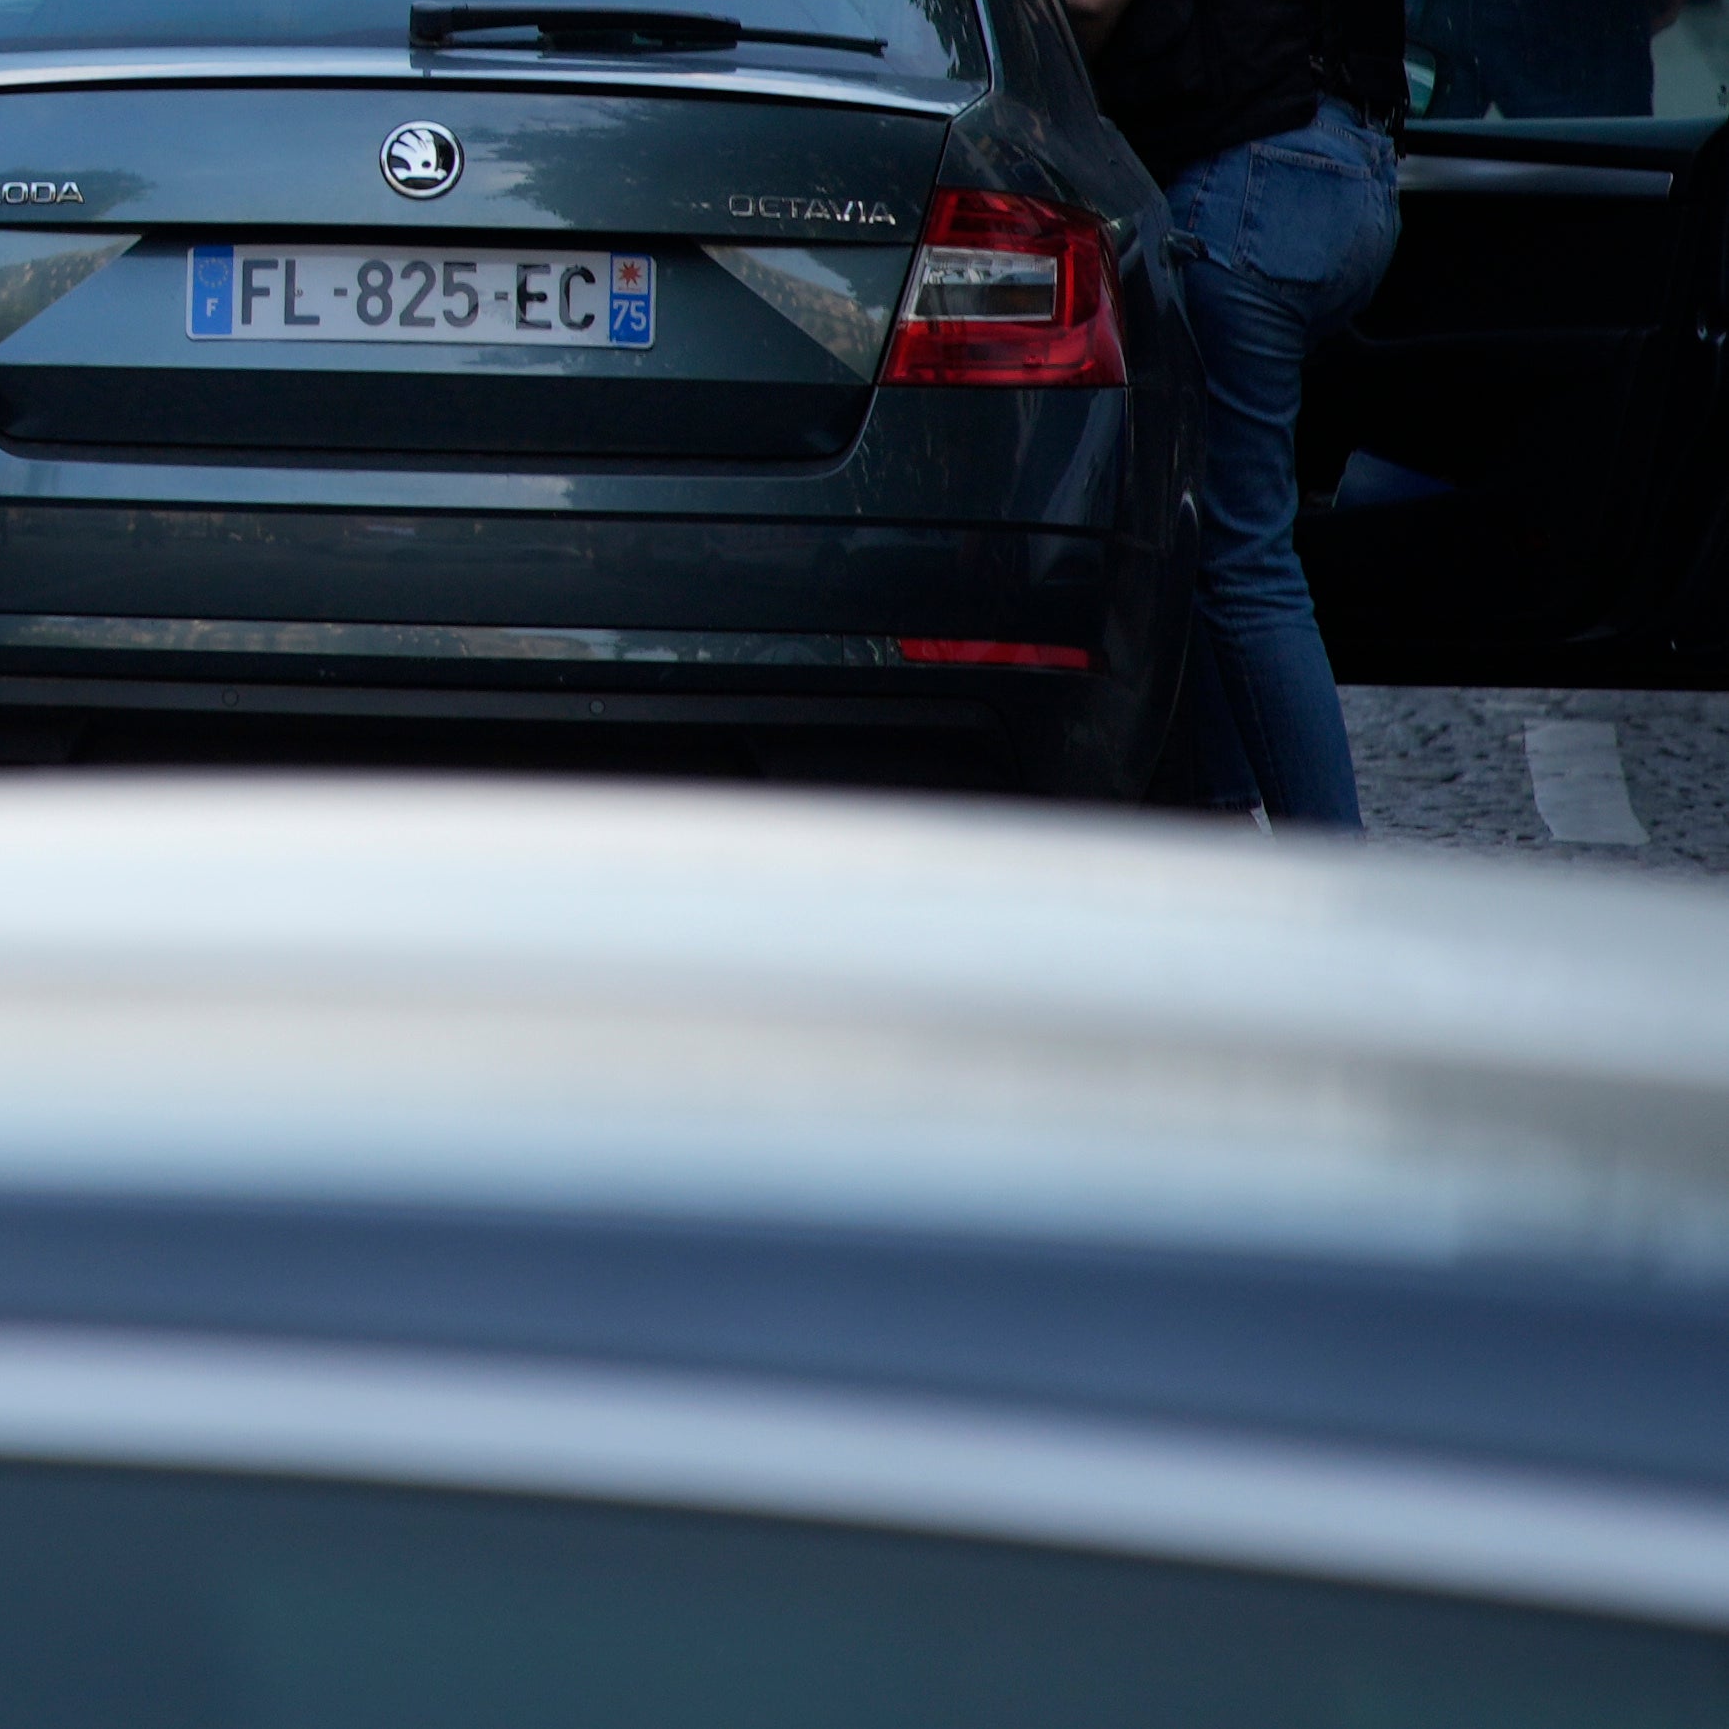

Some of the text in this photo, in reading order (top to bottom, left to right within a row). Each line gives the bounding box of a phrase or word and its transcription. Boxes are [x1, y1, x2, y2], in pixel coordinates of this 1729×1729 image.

[729, 194, 896, 226] OCTAVIA
[205, 258, 648, 332] F FL-825-EC 75
